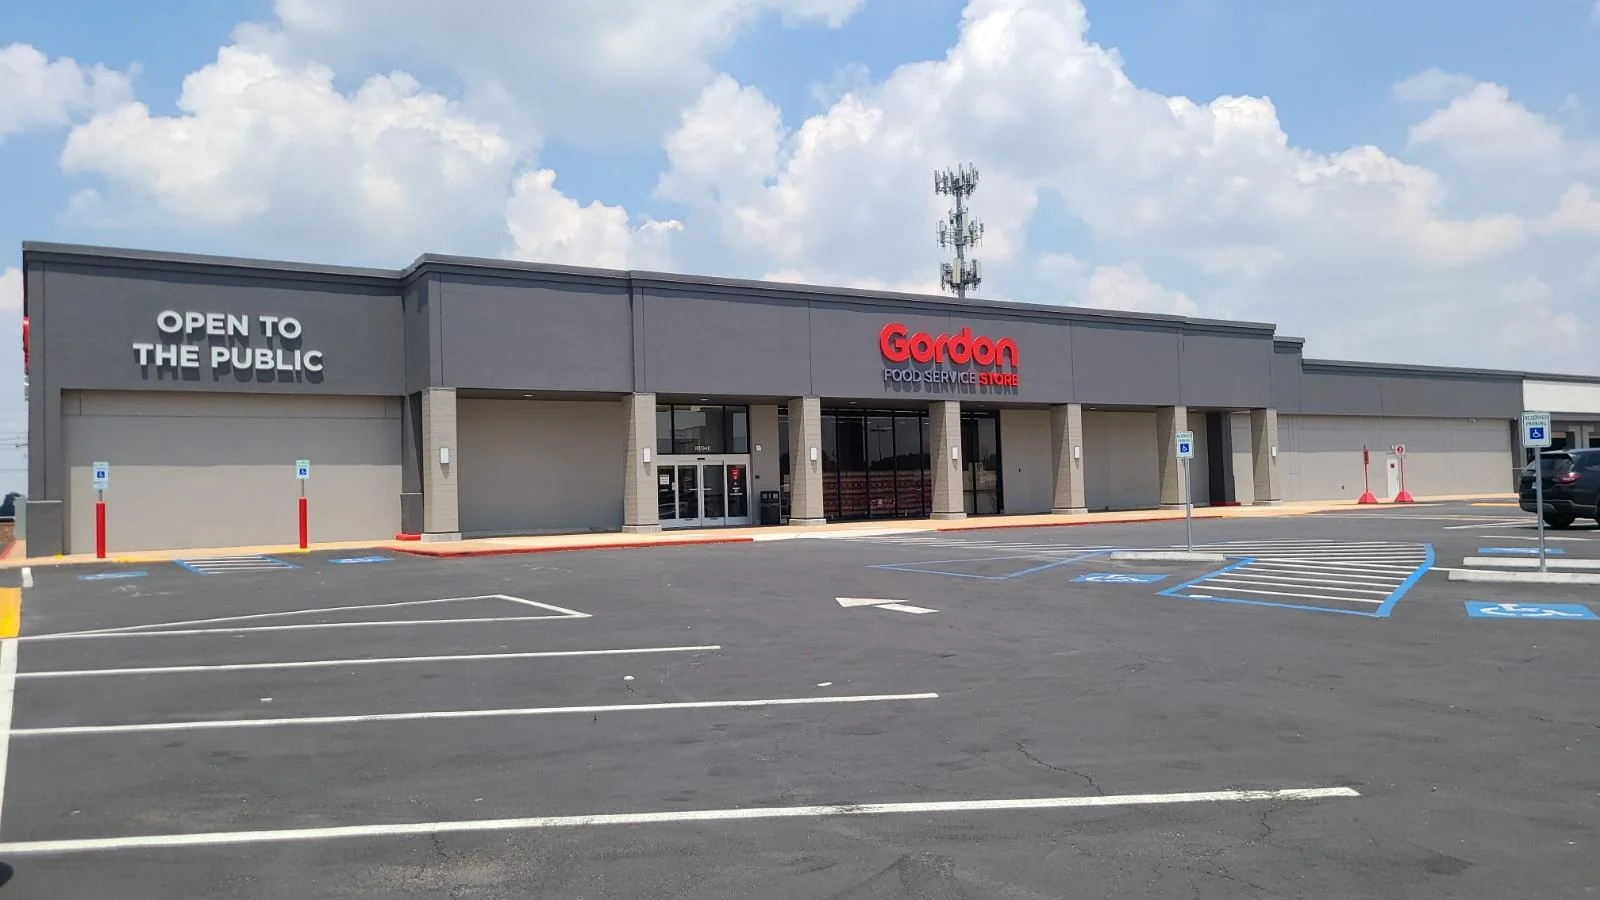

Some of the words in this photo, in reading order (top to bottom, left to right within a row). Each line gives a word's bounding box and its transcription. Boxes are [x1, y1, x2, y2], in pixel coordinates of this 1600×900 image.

[157, 310, 249, 336] OPEN
[259, 316, 302, 339] TO
[133, 343, 200, 367] THE
[211, 346, 324, 371] PUBLIC
[880, 322, 1019, 367] Gordon
[884, 369, 921, 382] FOOD
[924, 370, 976, 384] SERVICE
[979, 372, 1019, 387] STORE
